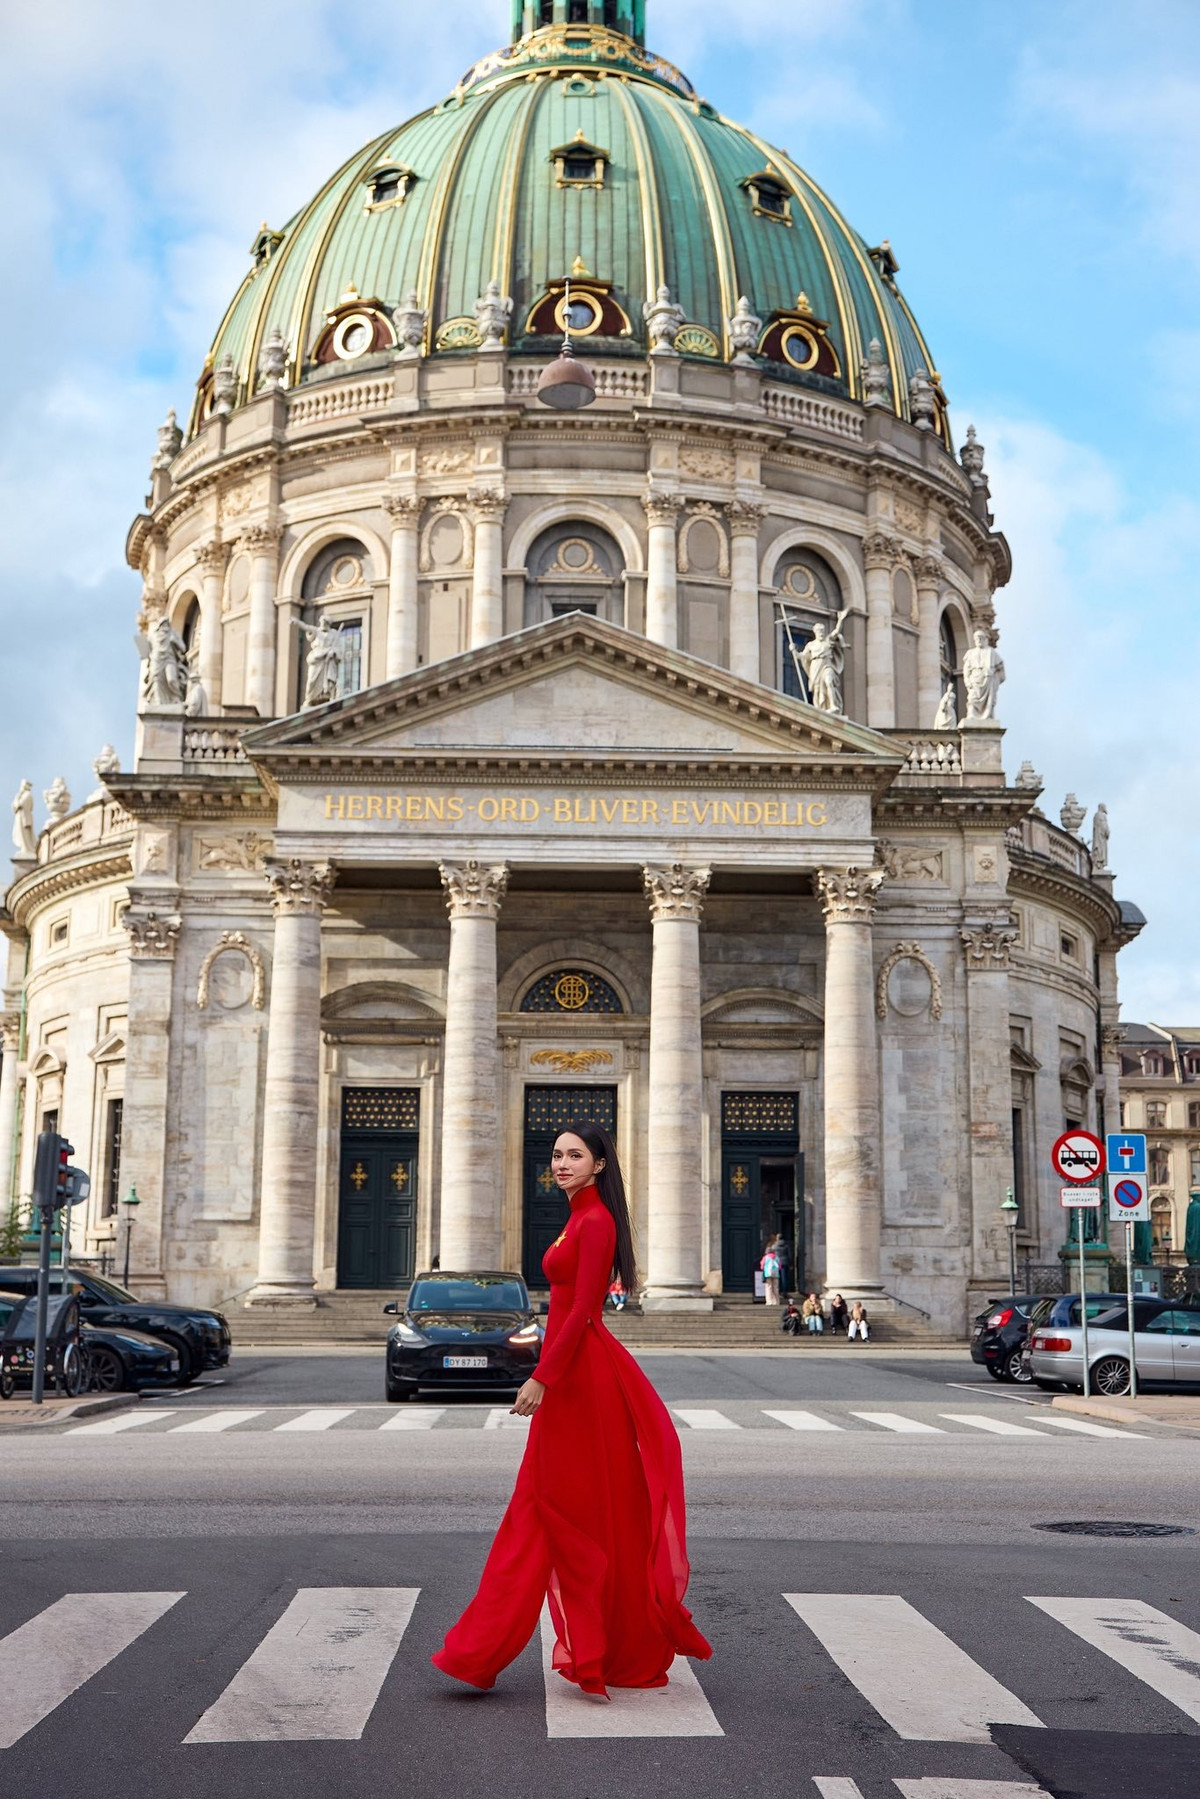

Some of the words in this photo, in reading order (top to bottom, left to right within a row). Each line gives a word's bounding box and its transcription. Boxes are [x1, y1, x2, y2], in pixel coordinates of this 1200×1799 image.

[325, 795, 464, 821] HERRENS
[477, 798, 540, 822] ORD
[554, 798, 659, 824] BLIVER
[671, 800, 827, 827] EVINDELIG
